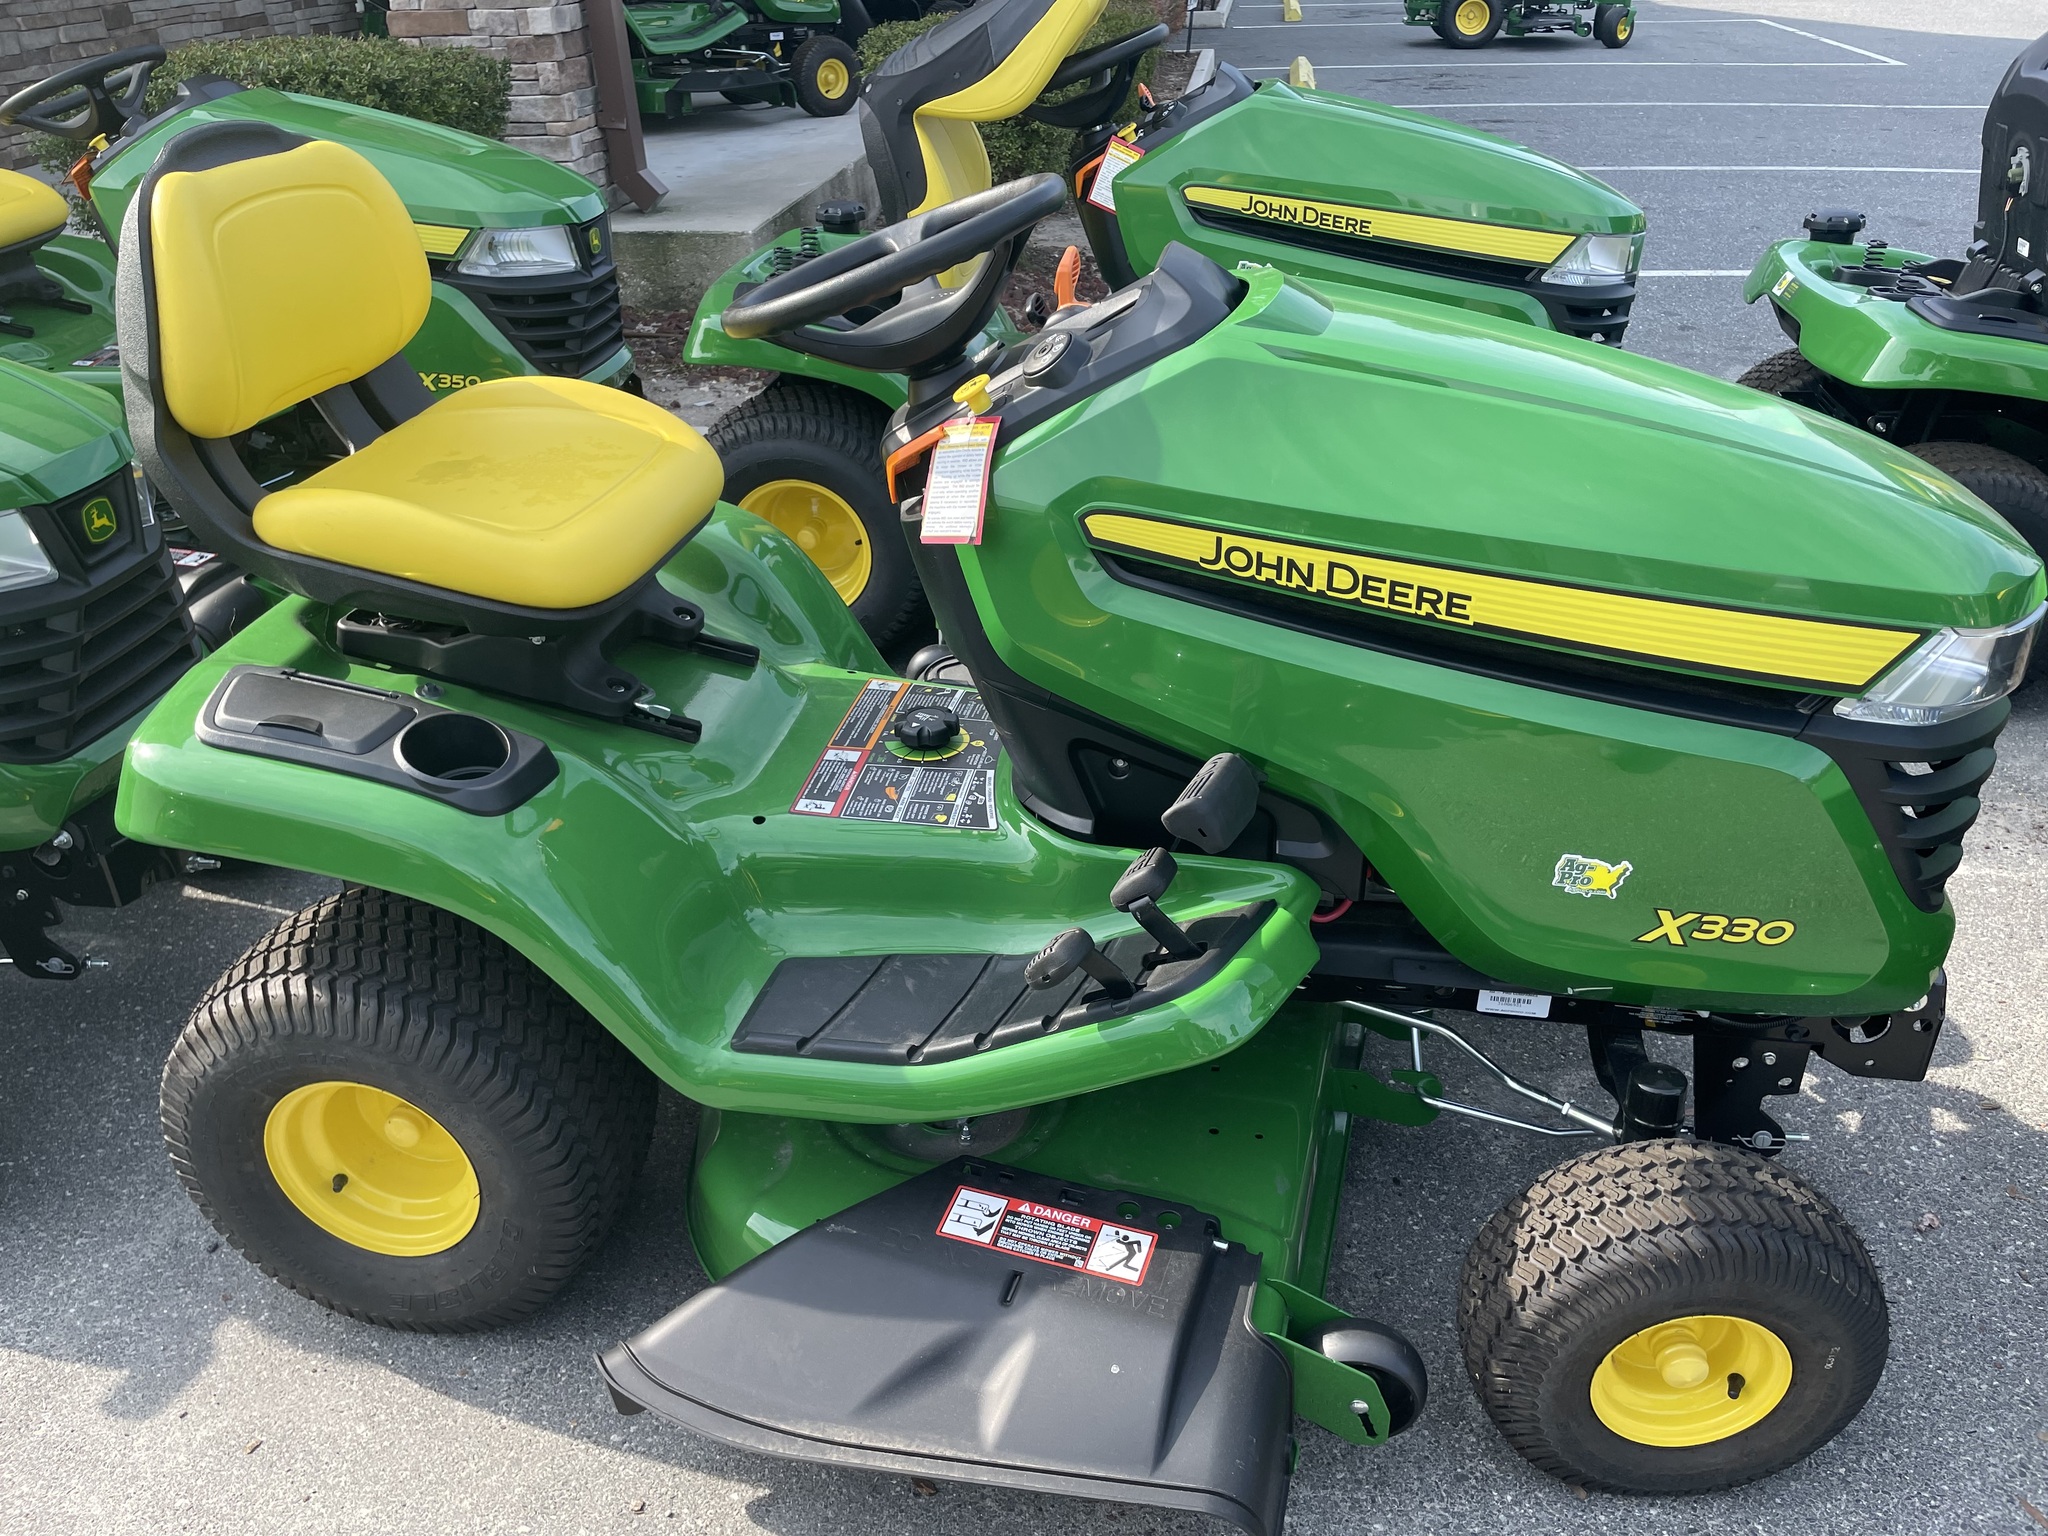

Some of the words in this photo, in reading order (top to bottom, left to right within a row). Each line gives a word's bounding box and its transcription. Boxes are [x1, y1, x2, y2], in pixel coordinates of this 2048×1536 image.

[1241, 195, 1298, 222] JOHN
[1303, 206, 1373, 236] DEERE
[1199, 536, 1315, 588] JOHN
[1326, 561, 1473, 622] DEERE
[1632, 908, 1796, 947] X330
[1021, 1214, 1056, 1227] ROTATING
[1057, 1223, 1080, 1233] BLADE
[1033, 1206, 1091, 1228] DANGER
[1014, 1225, 1045, 1237] THROWN
[1045, 1233, 1078, 1245] OBJECTS
